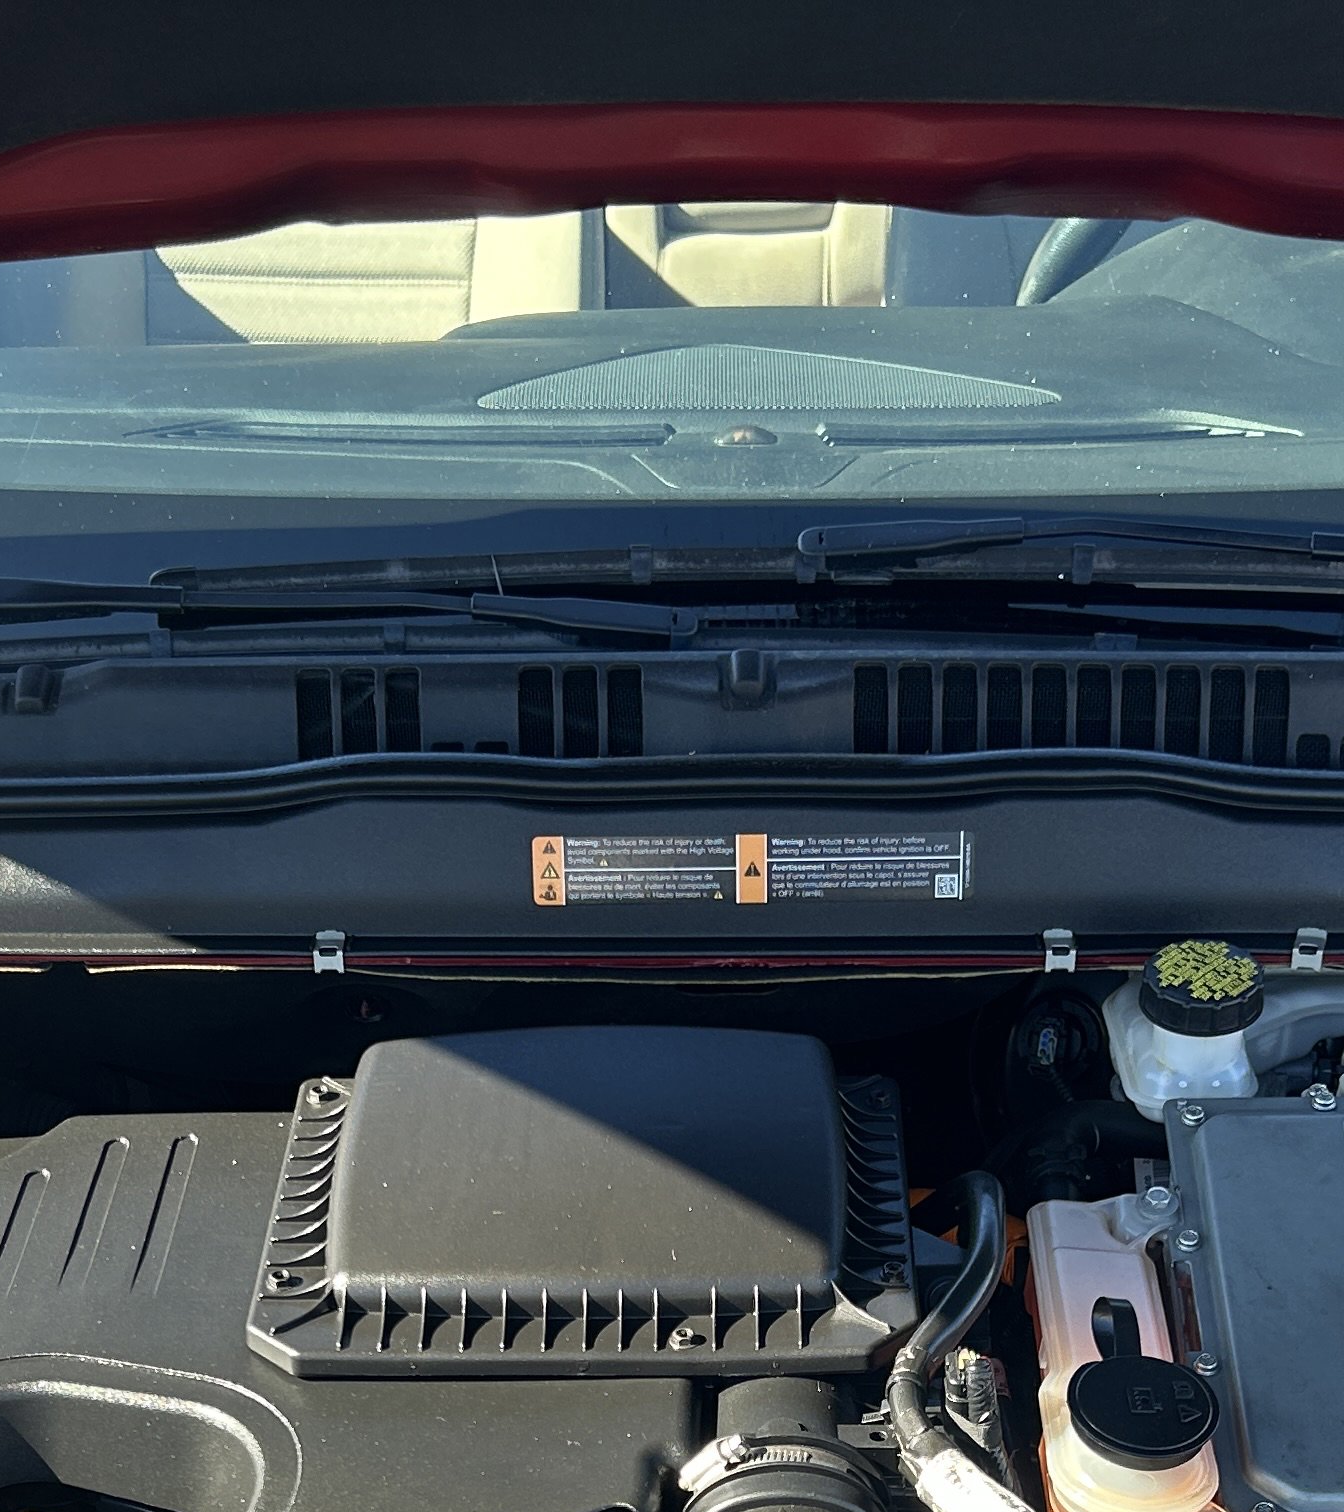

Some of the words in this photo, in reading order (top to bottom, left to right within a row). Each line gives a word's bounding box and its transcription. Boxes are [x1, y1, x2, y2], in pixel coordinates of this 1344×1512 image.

[871, 837, 879, 845] of
[902, 836, 926, 844] before
[689, 847, 706, 856] High
[707, 846, 734, 856] Voltage
[771, 848, 800, 856] working
[898, 845, 924, 854] ignition
[902, 880, 930, 888] position
